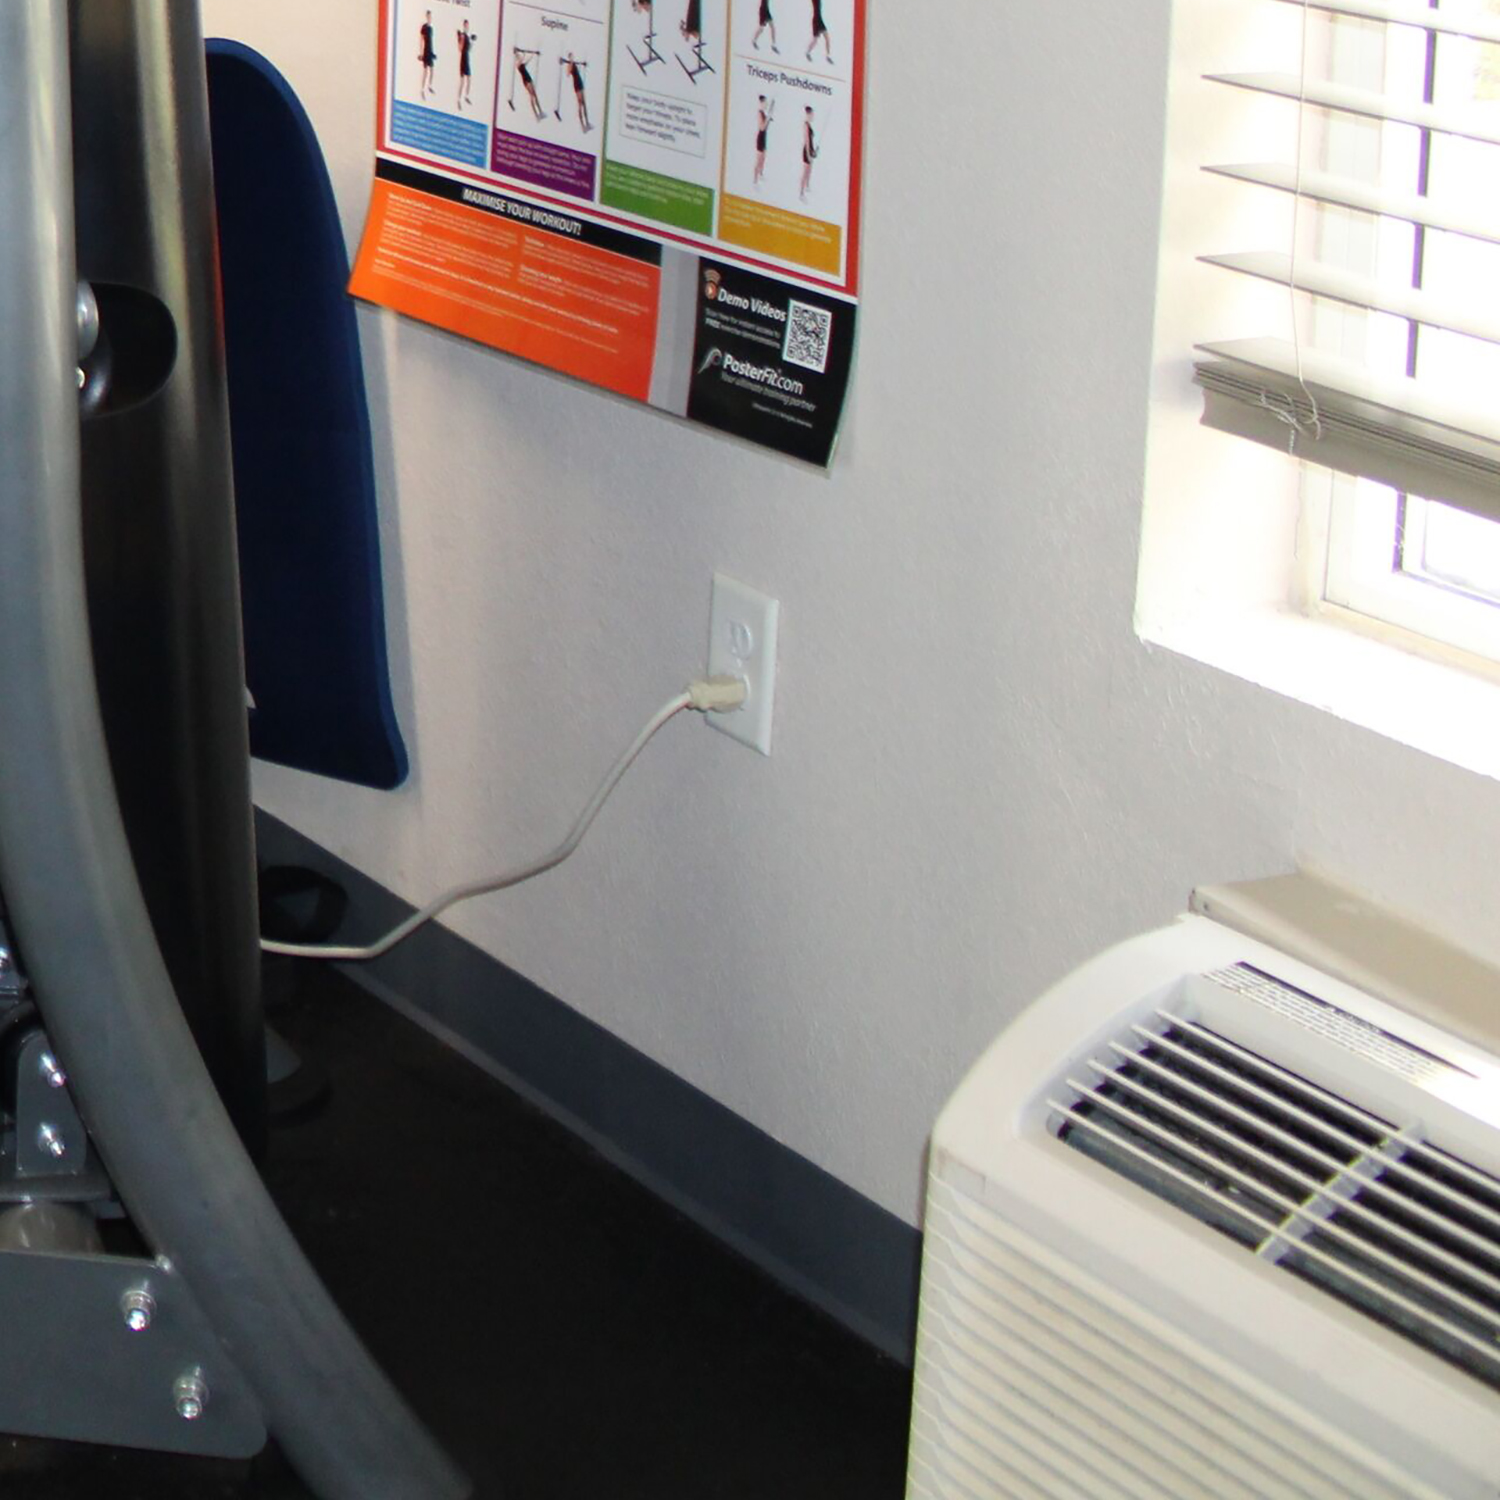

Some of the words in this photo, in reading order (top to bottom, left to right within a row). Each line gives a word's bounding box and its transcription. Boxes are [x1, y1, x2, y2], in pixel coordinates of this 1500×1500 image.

[540, 15, 569, 32] Supine
[746, 64, 778, 84] Triceps
[779, 71, 833, 97] Pushdowns
[462, 187, 507, 213] MAXIMISE
[507, 200, 533, 222] YOUR
[532, 206, 583, 236] WORKOUT!
[717, 287, 750, 310] Demo
[750, 297, 787, 322] Videos
[723, 353, 804, 395] PosterFit.com
